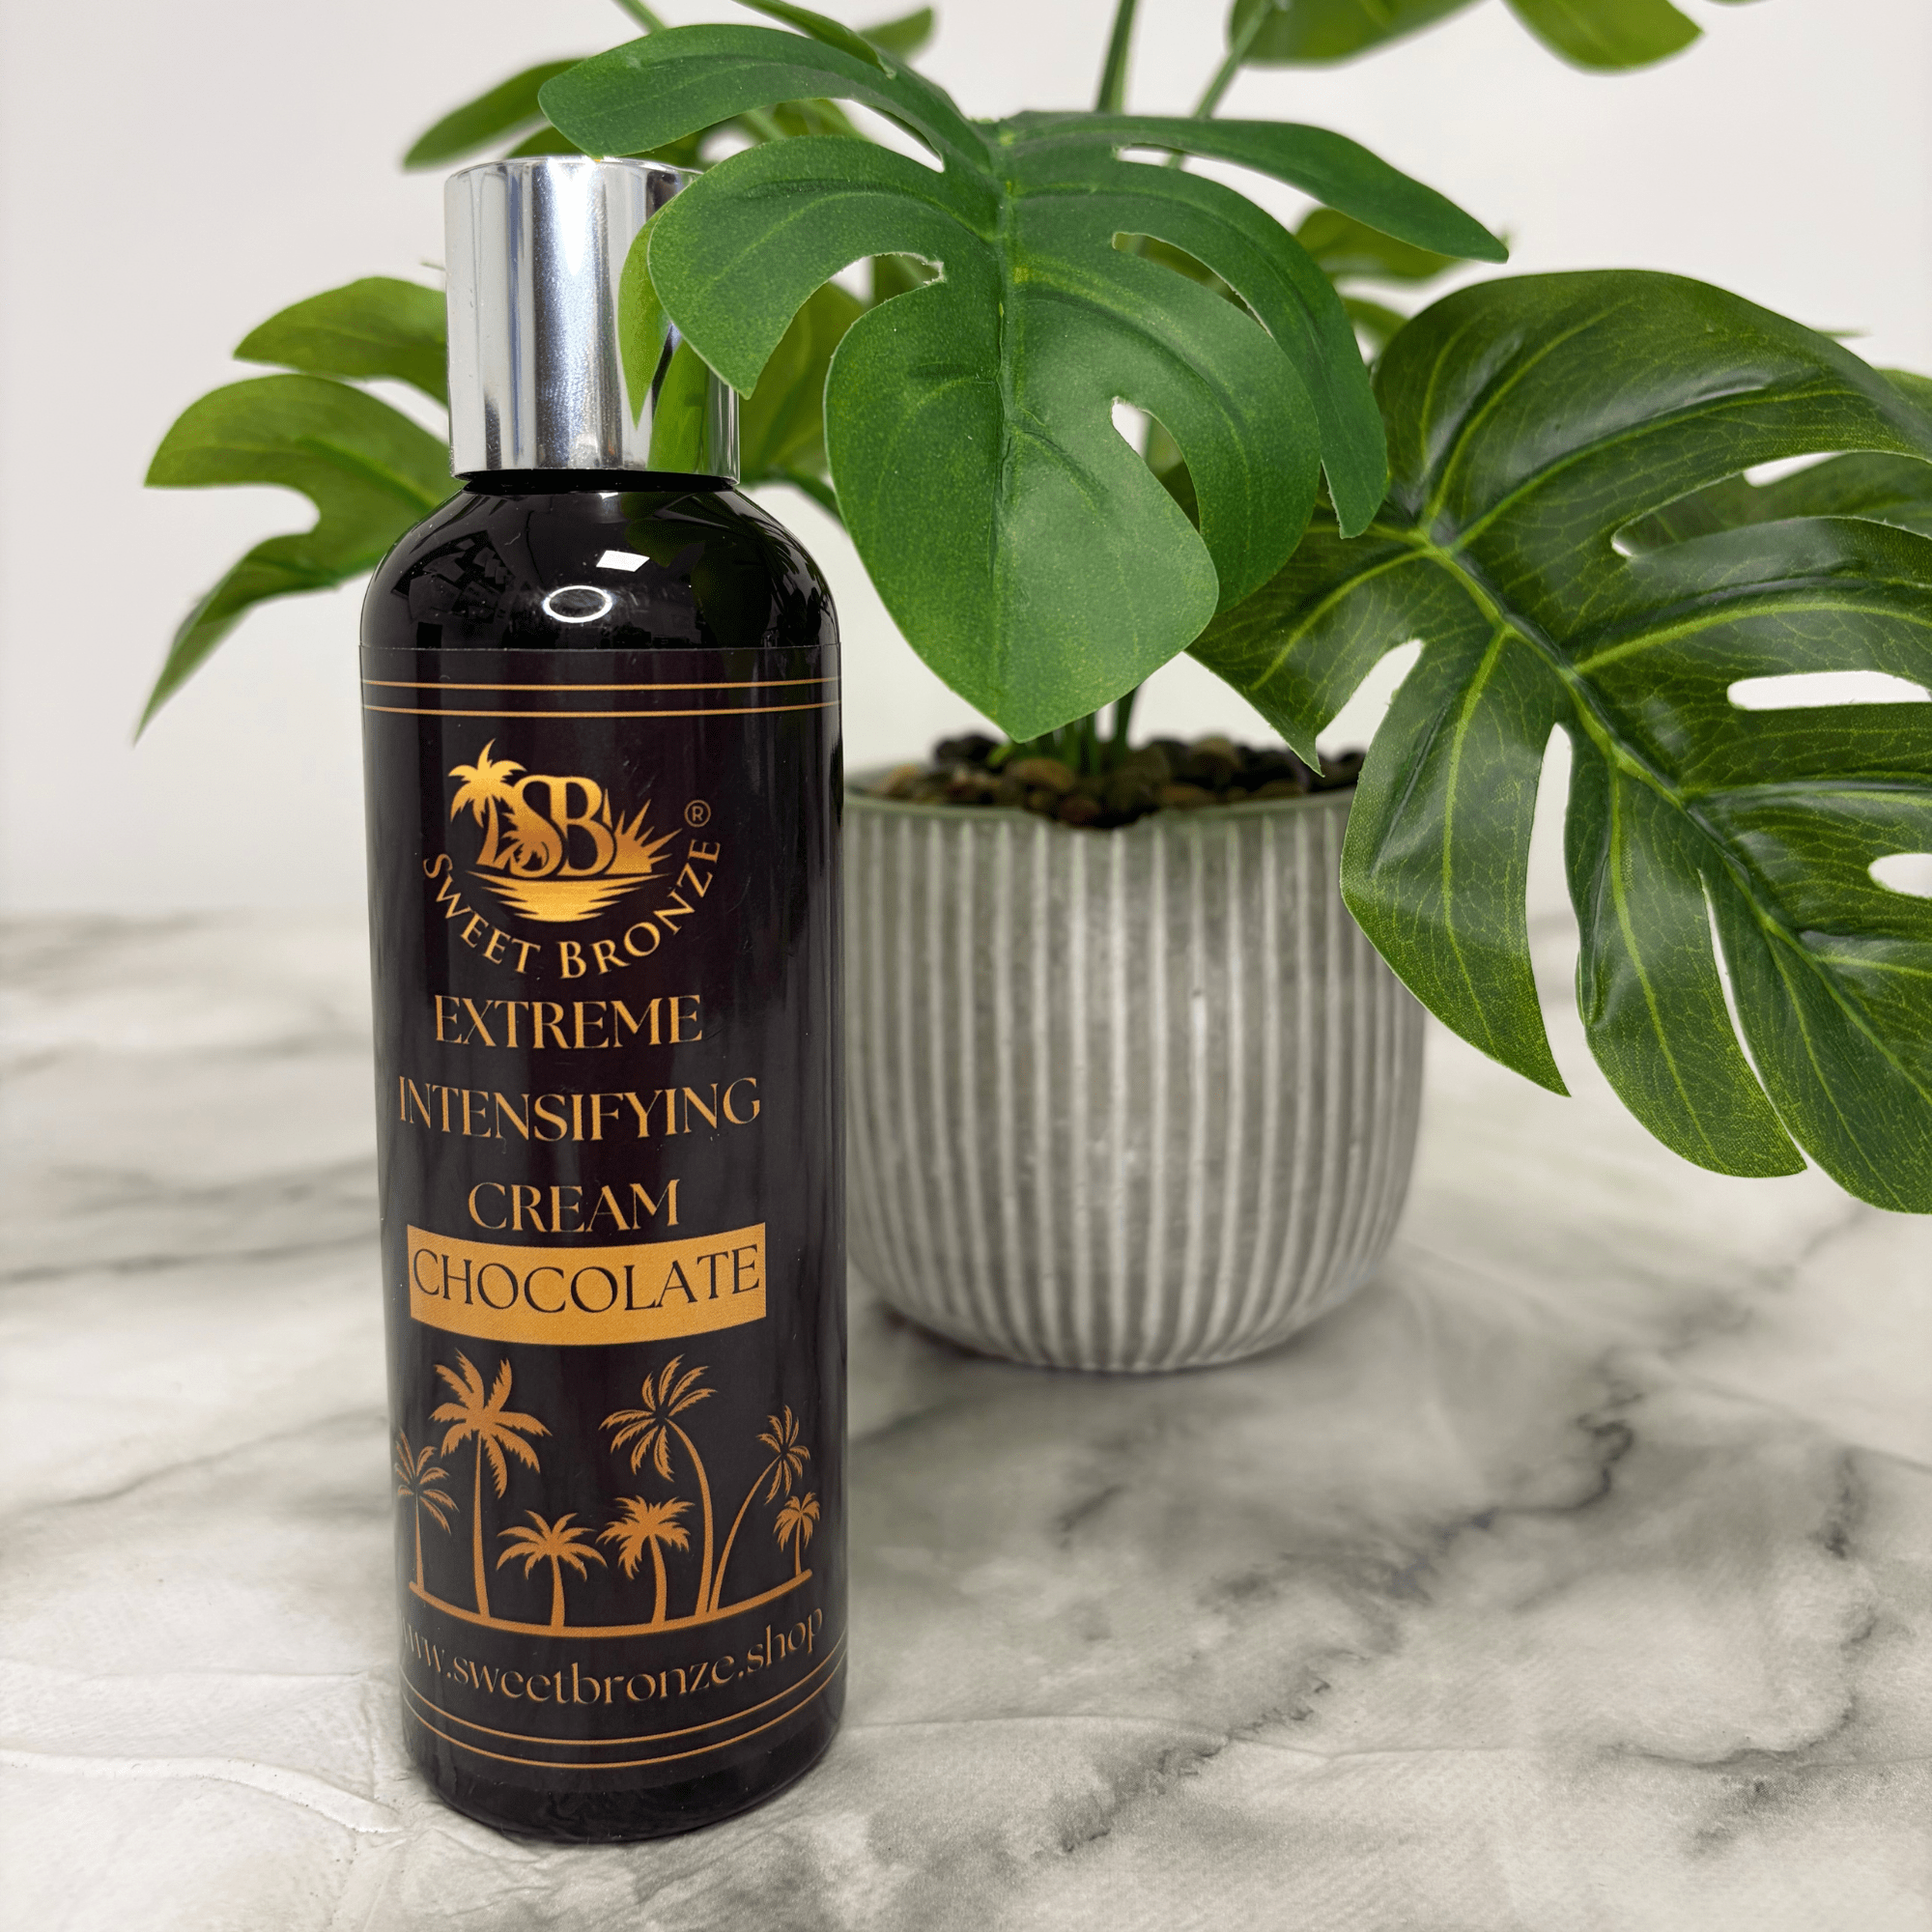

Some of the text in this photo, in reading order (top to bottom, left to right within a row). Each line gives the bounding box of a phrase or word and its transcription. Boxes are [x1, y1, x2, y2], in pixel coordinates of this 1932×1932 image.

[424, 838, 721, 980] SWEET BRONZE
[434, 994, 703, 1050] EXTREME
[398, 1076, 761, 1142] INTENSIFYING
[469, 1179, 681, 1234] CREAM
[412, 1243, 760, 1314] CHOCOLATE
